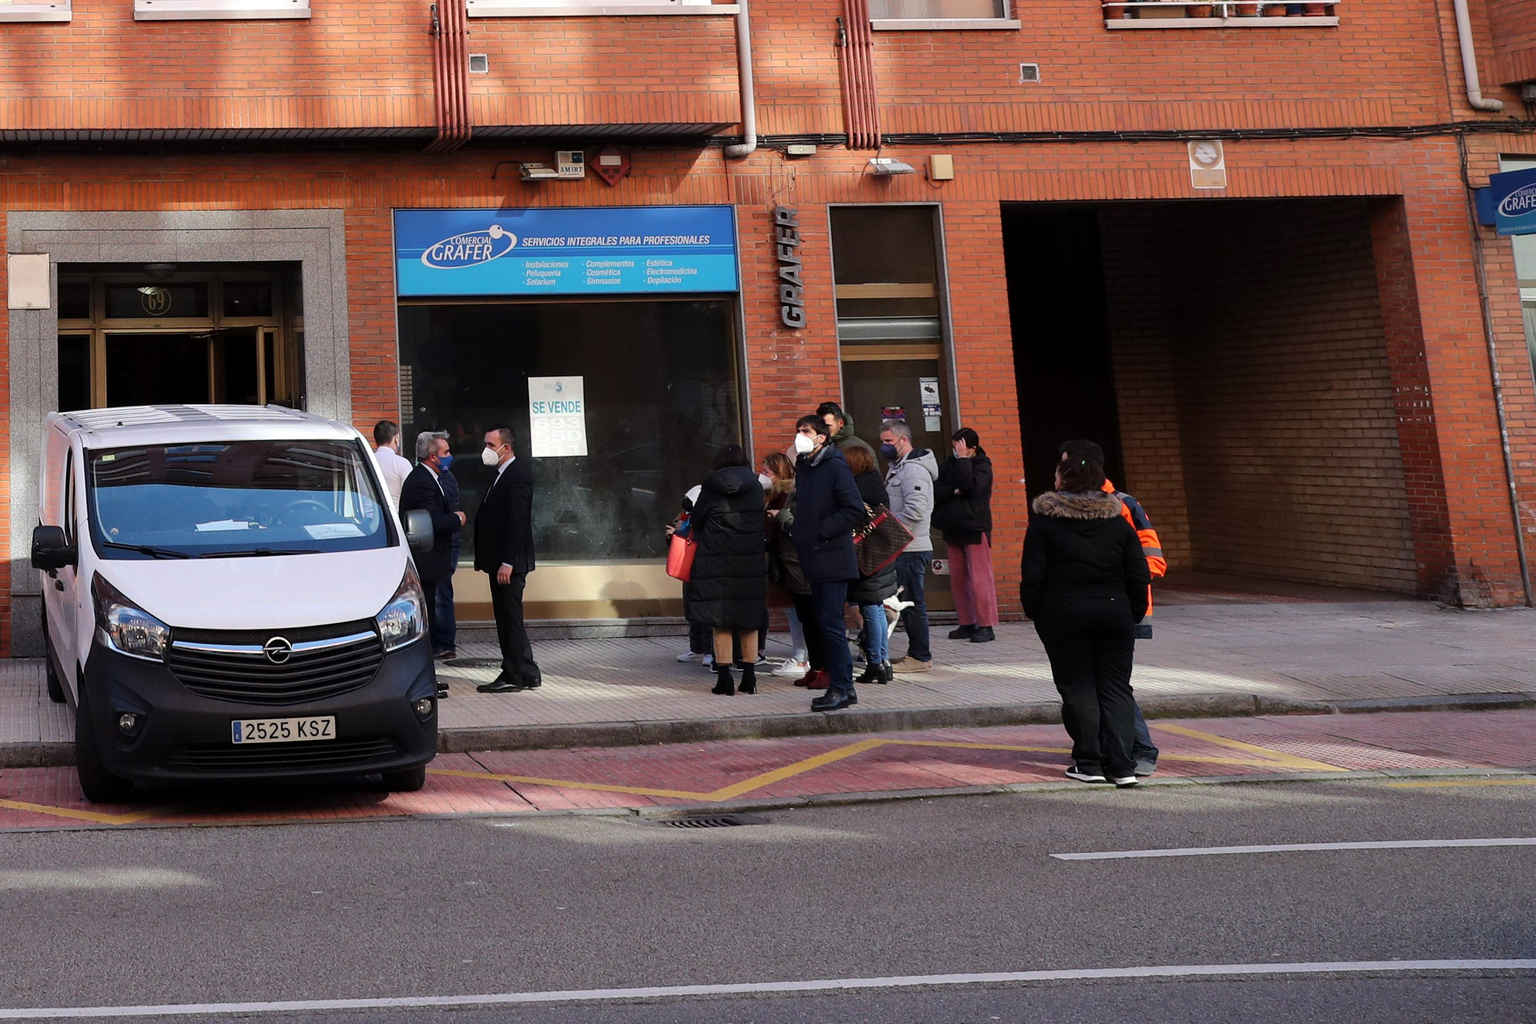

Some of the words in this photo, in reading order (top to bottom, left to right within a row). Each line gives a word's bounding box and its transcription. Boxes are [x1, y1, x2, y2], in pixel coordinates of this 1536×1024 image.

[450, 236, 493, 245] COMERCIAL
[521, 237, 565, 246] SERVICIOS
[567, 236, 618, 246] INTEGRALES
[619, 236, 642, 245] PARA
[643, 235, 710, 245] PROFESIONALES
[431, 244, 493, 261] GRAFER
[525, 260, 569, 268] Instalaciones
[586, 260, 635, 268] Complementos
[646, 259, 673, 267] Estética
[775, 206, 806, 329] GRAFER
[586, 268, 621, 276] Cosmética
[646, 267, 698, 275] Electromedicina
[526, 278, 556, 286] Solarium
[587, 277, 621, 285] Gimnasios
[647, 276, 682, 285] Depilación
[148, 292, 164, 310] 69
[532, 401, 546, 414] SE
[548, 400, 582, 413] VENDE
[534, 417, 582, 429] 693
[245, 721, 291, 740] 2525
[297, 719, 331, 738] KSZ
